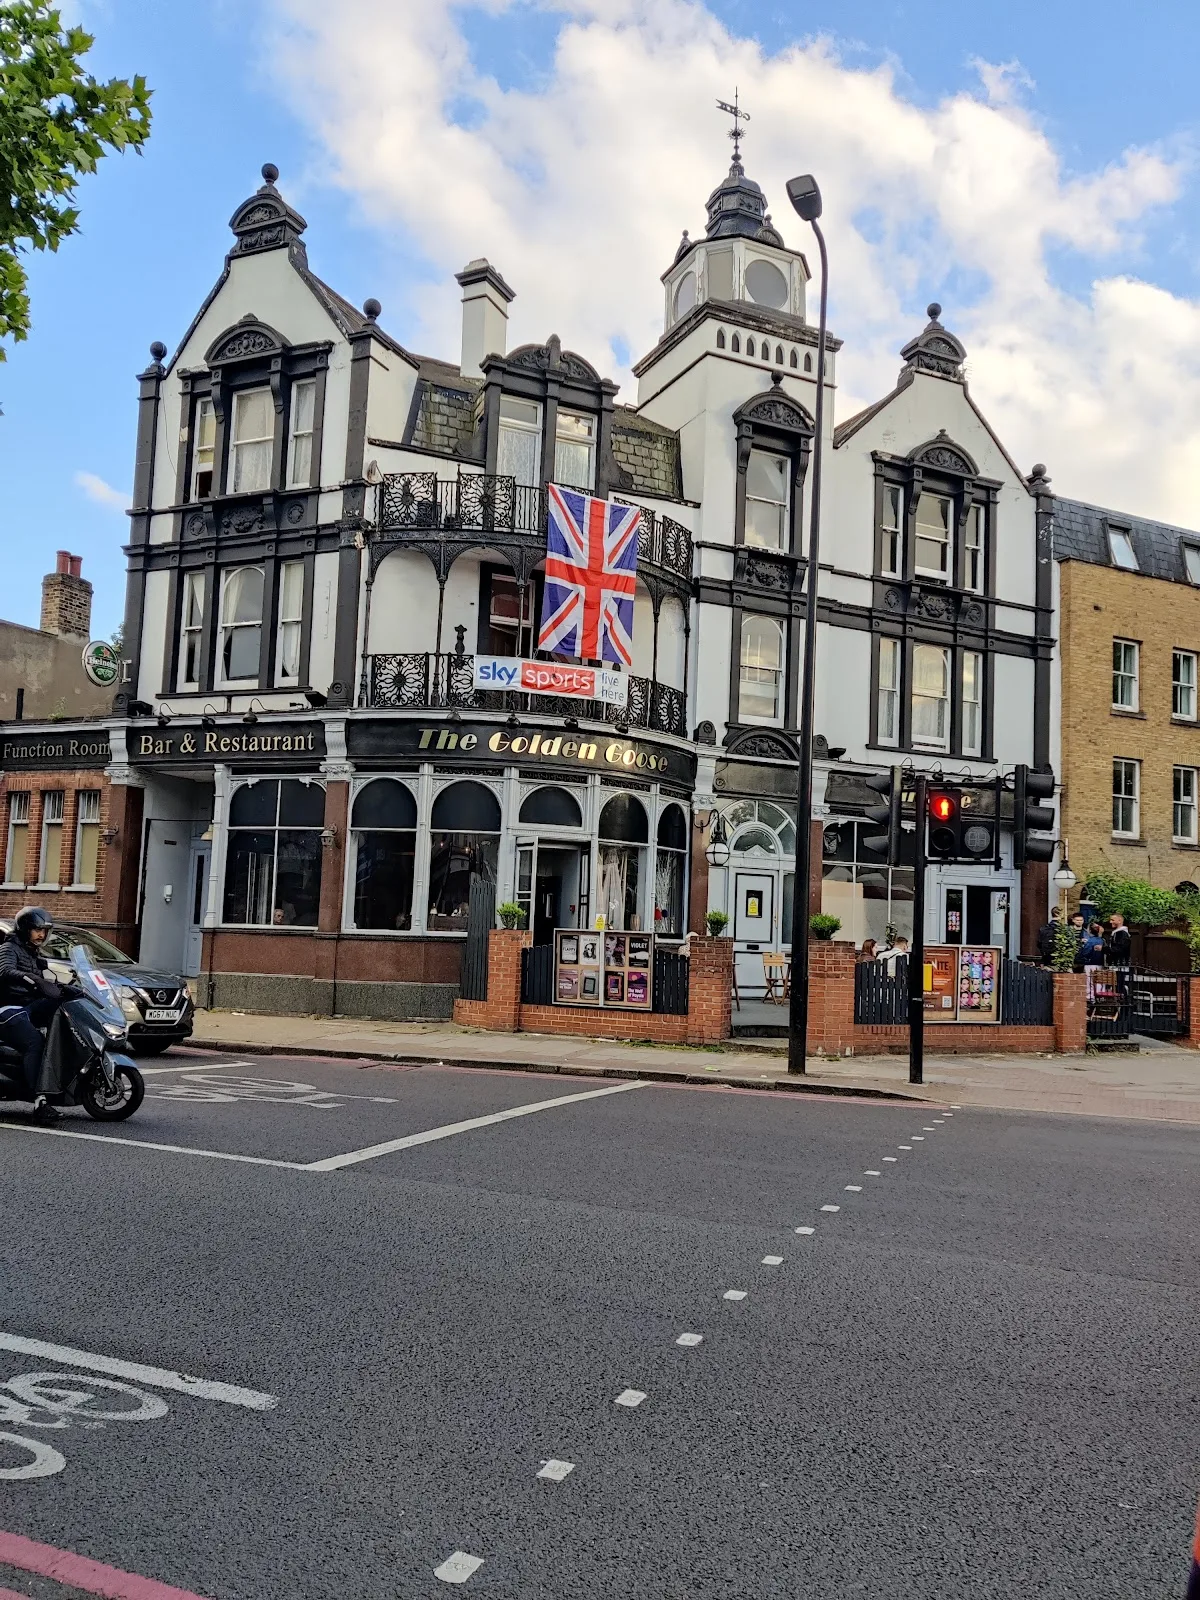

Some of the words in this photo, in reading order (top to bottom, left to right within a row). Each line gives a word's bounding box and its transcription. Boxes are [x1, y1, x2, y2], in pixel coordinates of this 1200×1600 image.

[479, 661, 518, 686] sky
[525, 669, 592, 690] sports
[601, 672, 619, 687] live
[601, 689, 625, 702] here
[2, 741, 64, 759] Function
[68, 739, 110, 756] Room
[139, 735, 173, 755] Bar
[179, 732, 197, 754] &
[203, 731, 315, 753] Restaurant
[418, 728, 478, 751] The
[488, 731, 598, 760] Golden
[604, 743, 670, 773] Goose
[95, 975, 107, 986] L
